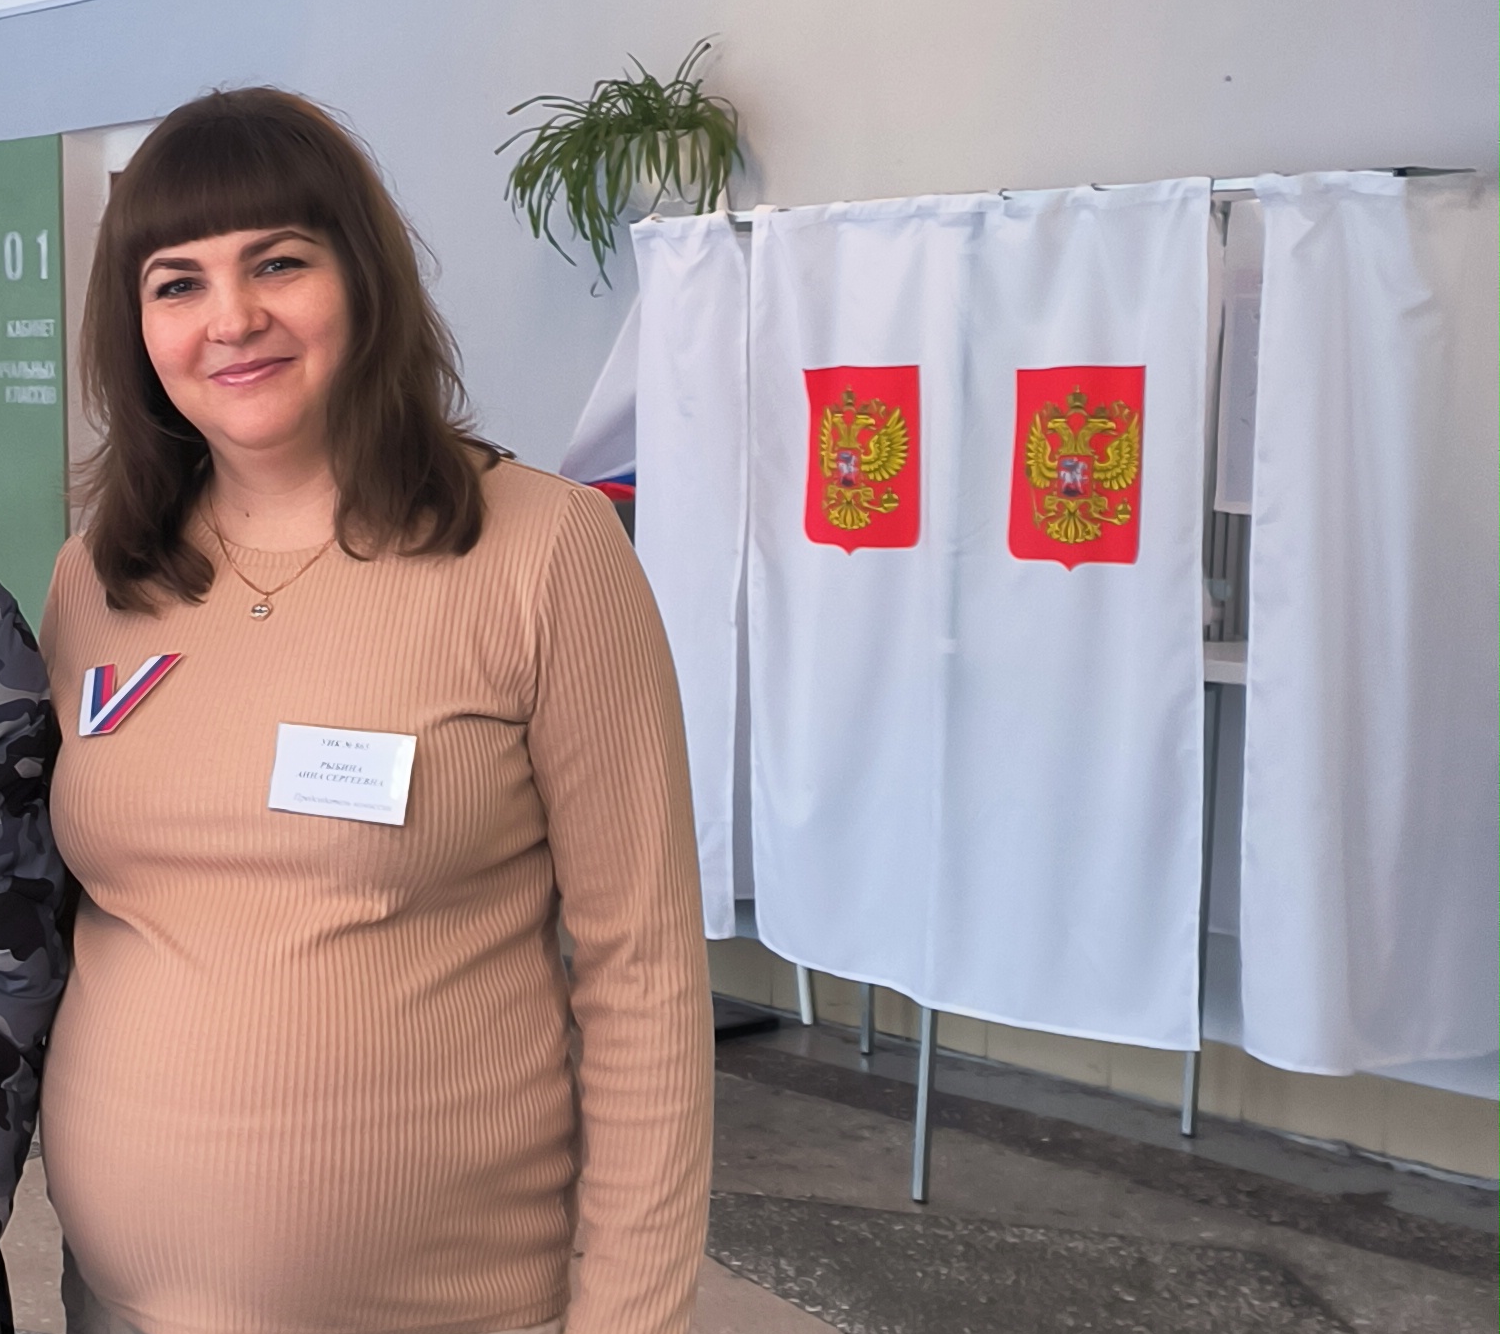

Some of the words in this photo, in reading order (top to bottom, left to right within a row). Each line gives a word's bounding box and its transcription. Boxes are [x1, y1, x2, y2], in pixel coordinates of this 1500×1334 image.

[320, 761, 363, 773] РЫБИНА
[296, 771, 323, 780] АННА
[326, 773, 384, 787] СЕРГЕЕВНА
